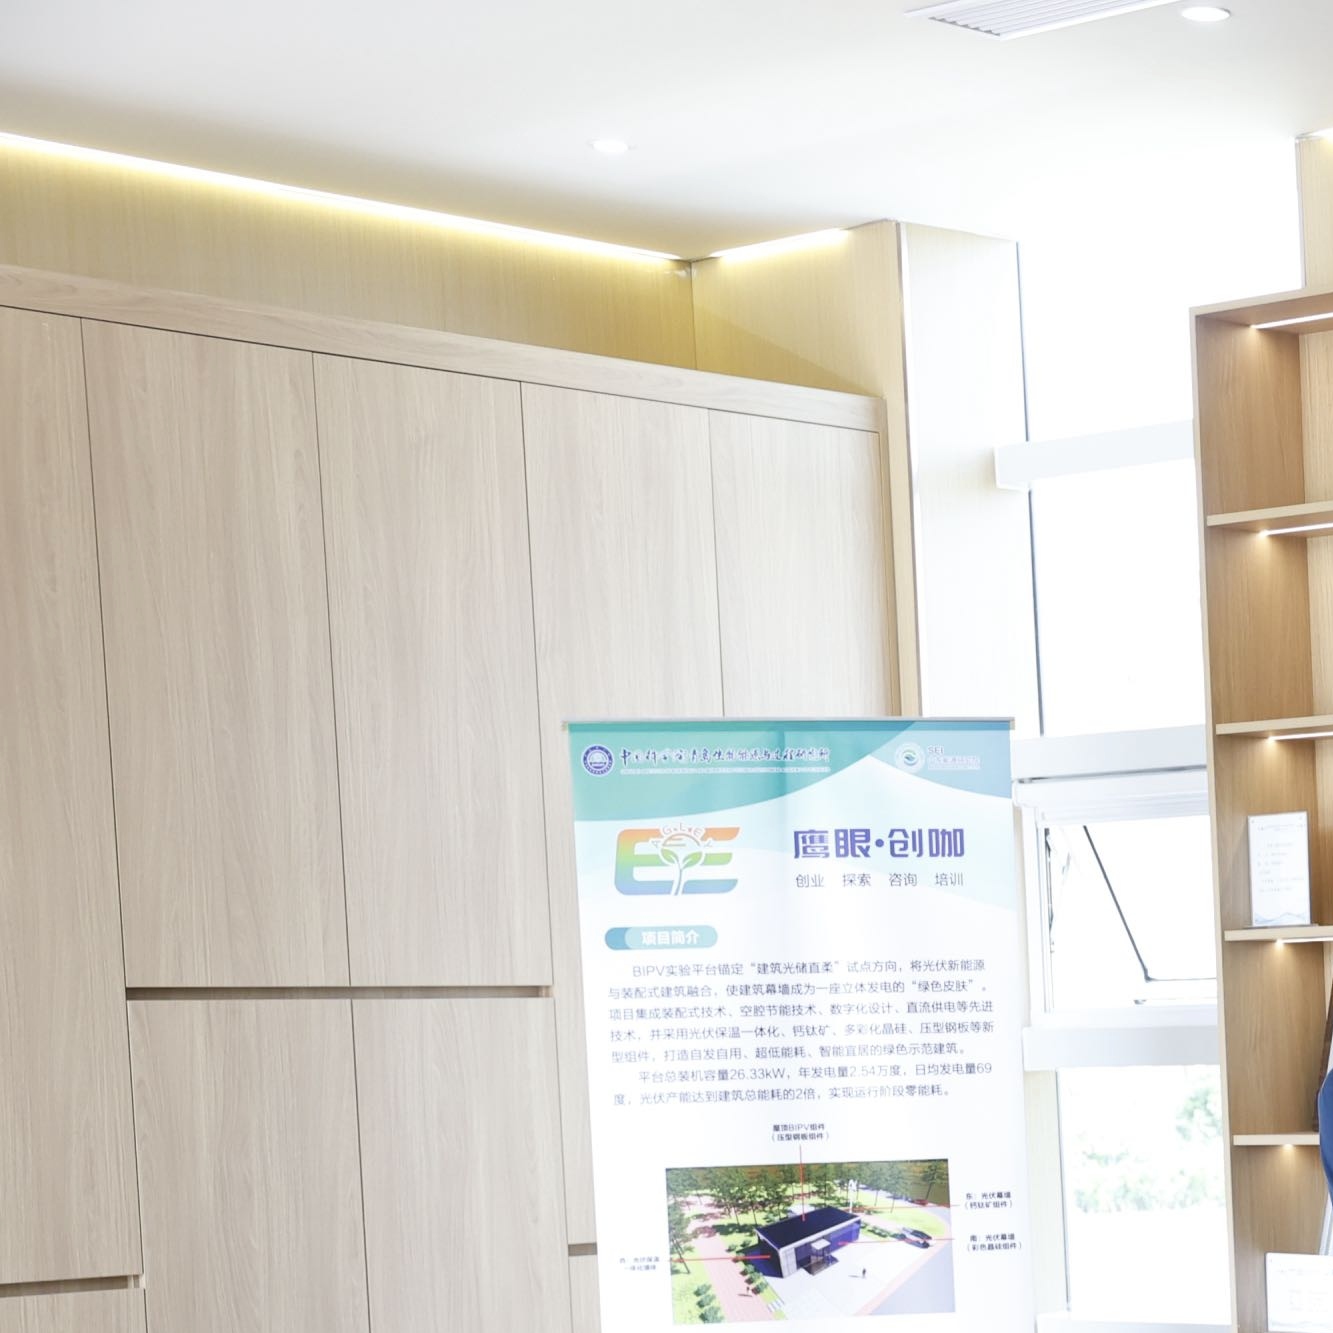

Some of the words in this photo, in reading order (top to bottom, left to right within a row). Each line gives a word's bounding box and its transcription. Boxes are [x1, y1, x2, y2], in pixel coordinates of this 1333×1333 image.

[795, 873, 824, 888] 创业
[842, 873, 872, 888] 探索
[888, 872, 917, 887] 咨询
[935, 872, 964, 887] 培训
[641, 930, 701, 946] 项目简介
